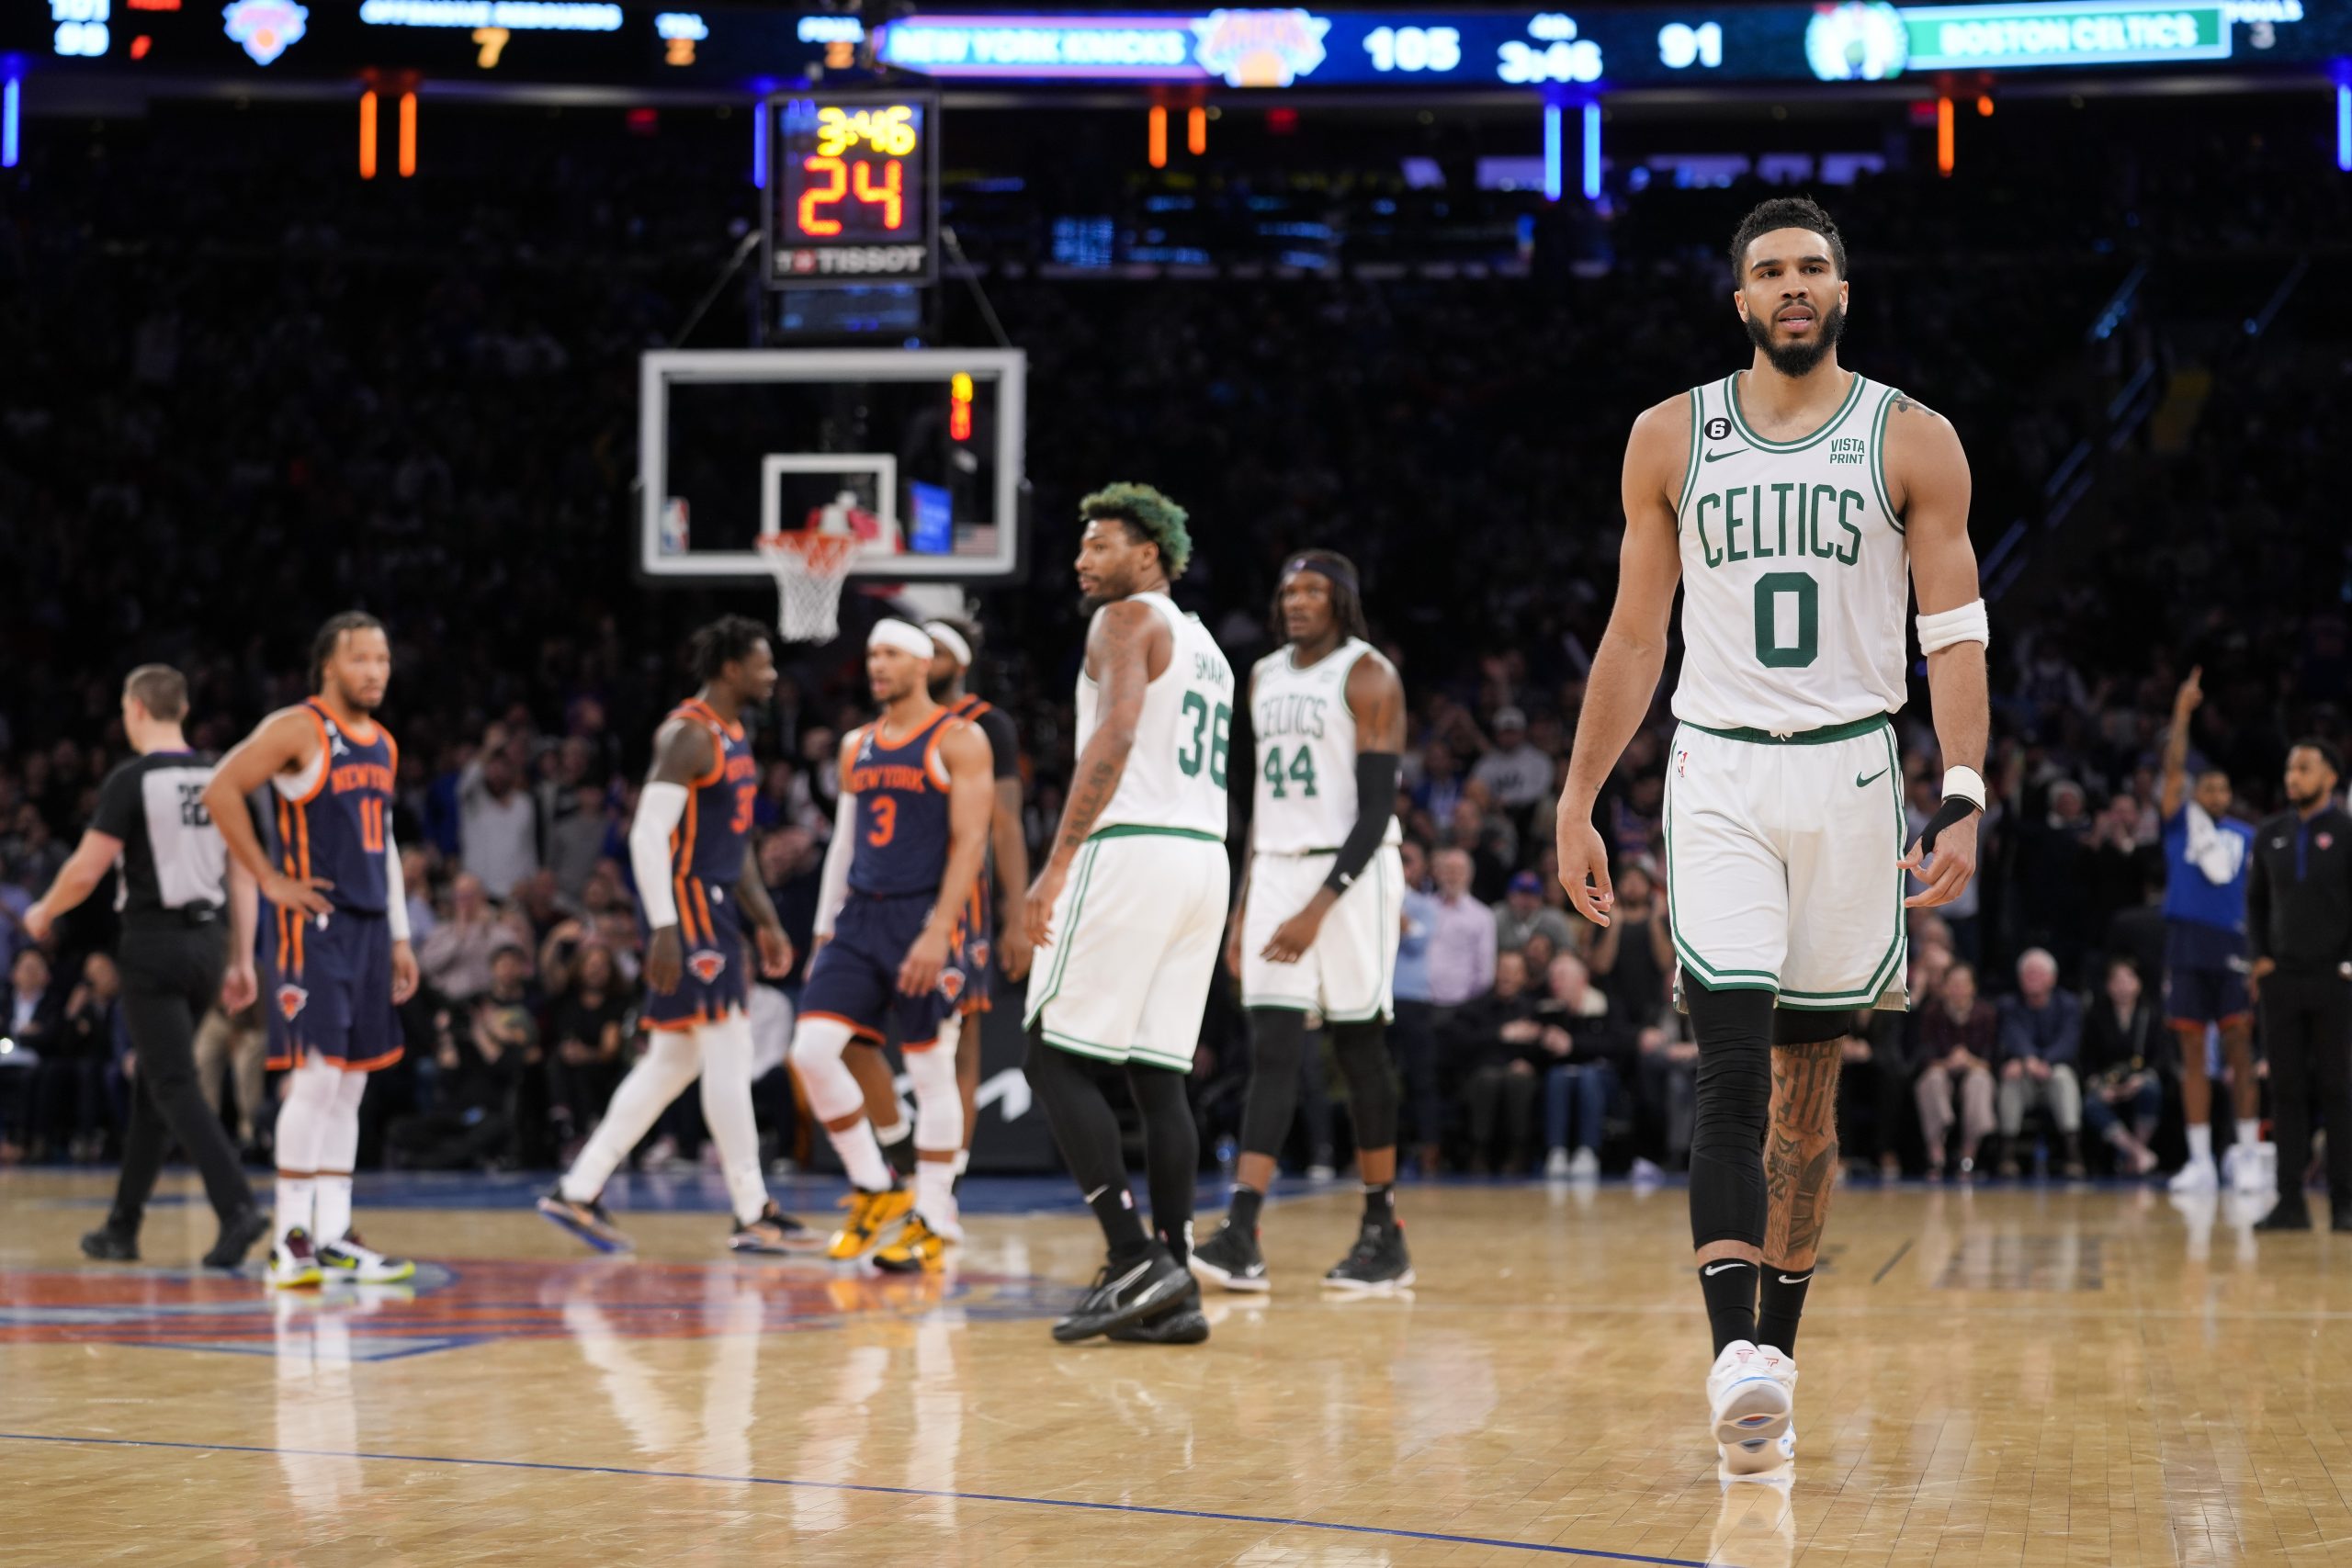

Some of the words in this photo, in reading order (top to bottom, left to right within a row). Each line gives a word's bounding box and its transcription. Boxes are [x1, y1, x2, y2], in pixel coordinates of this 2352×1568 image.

[471, 28, 510, 68] 7
[970, 28, 1059, 64] YORK
[1058, 28, 1187, 65] KNICKS
[1363, 27, 1461, 71] 105
[1658, 22, 1721, 68] 91
[1939, 17, 2070, 57] BOSTON
[2071, 12, 2199, 51] CELTICS
[797, 155, 903, 236] 24
[817, 245, 927, 274] TISSOT
[1711, 420, 1725, 438] 6
[1831, 437, 1865, 453] VISTA
[1829, 453, 1865, 465] PRINT
[1697, 482, 1864, 569] CELTICS
[1754, 571, 1819, 668] 0
[1260, 694, 1328, 739] CELTICS
[1179, 689, 1232, 791] 36
[1263, 744, 1317, 798] 44
[358, 796, 384, 852] 11
[867, 795, 897, 847] 3
